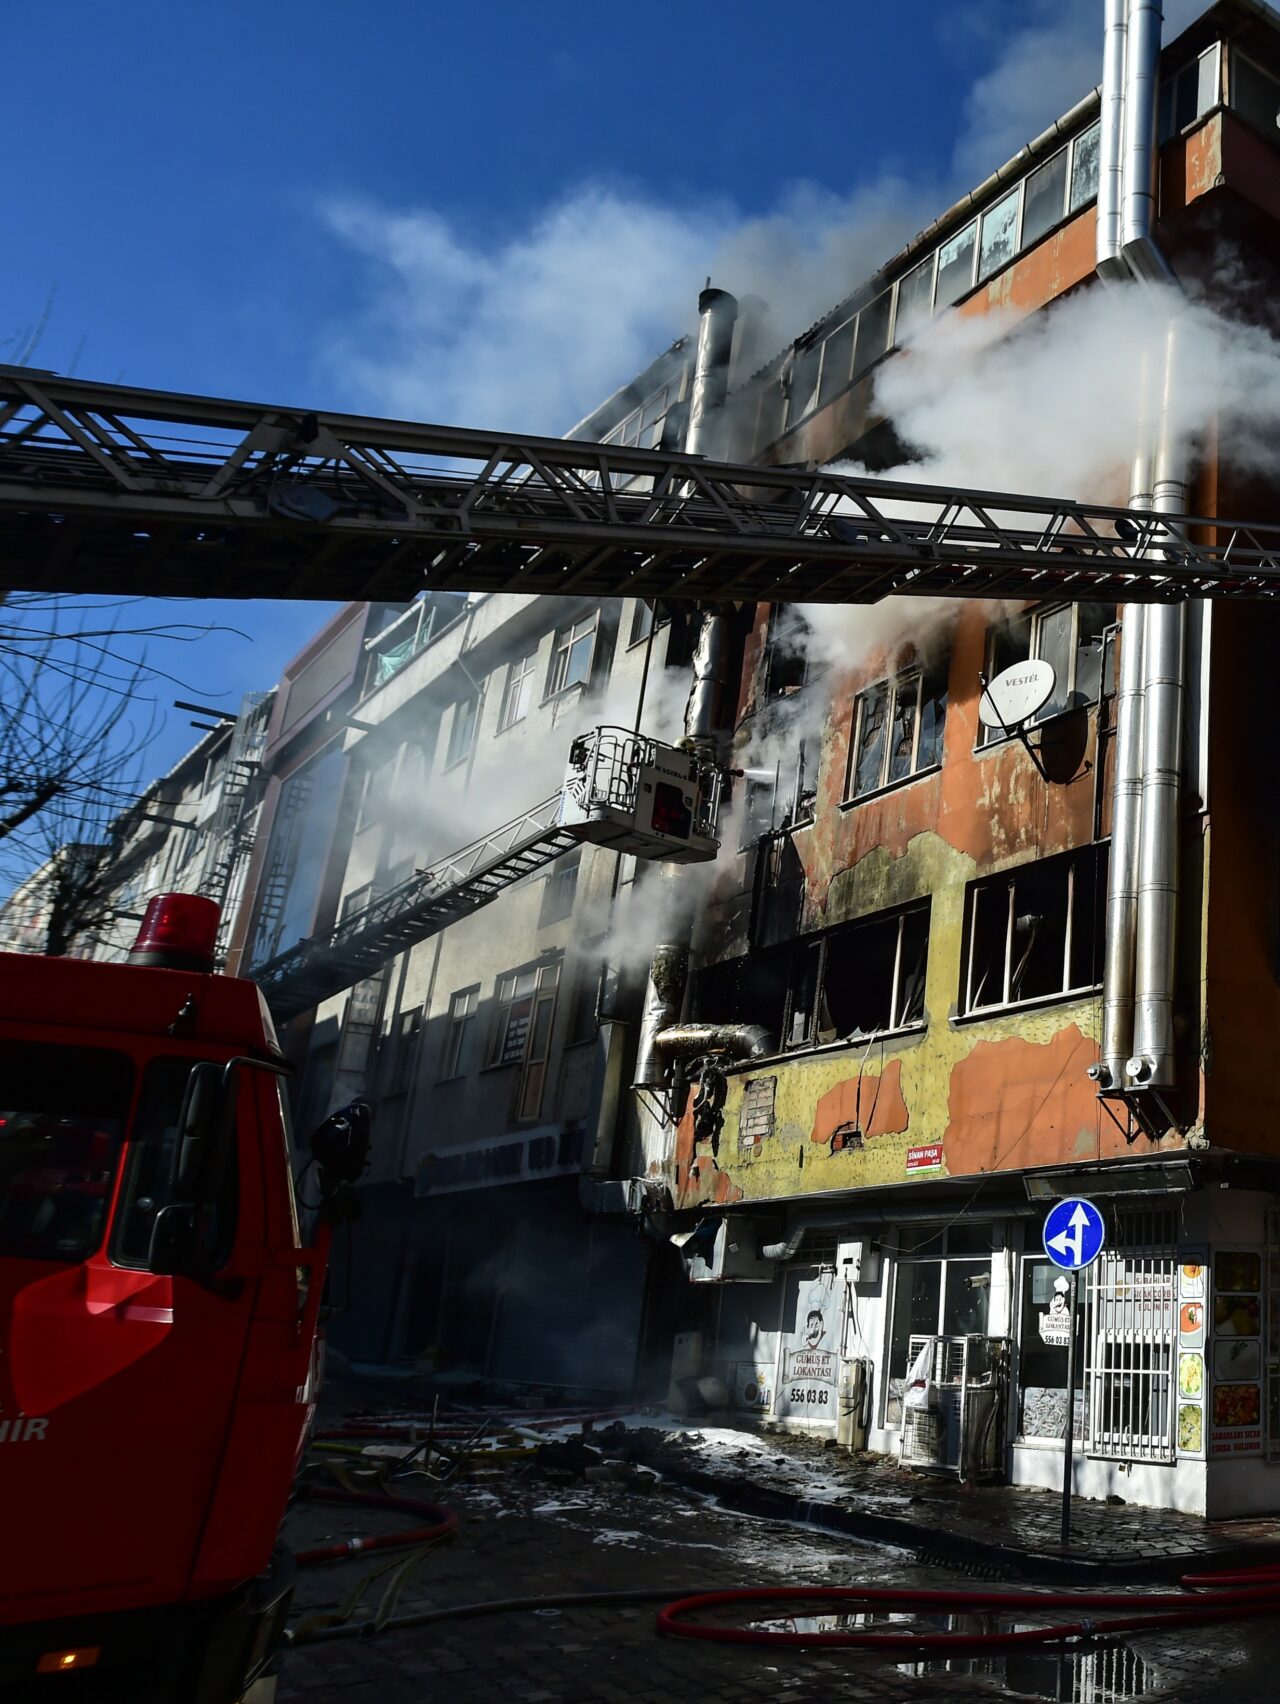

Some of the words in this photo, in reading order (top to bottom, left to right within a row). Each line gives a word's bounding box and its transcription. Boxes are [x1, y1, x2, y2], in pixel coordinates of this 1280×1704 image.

[1005, 673, 1040, 687] VESTEL
[924, 1148, 938, 1159] PAŞA
[1138, 1303, 1170, 1312] BULNR
[1045, 1335, 1055, 1344] 556
[1055, 1336, 1063, 1344] 03
[796, 1352, 821, 1367] GÜMÜŞ
[821, 1355, 831, 1365] ET
[793, 1366, 832, 1378] LOKANTASI
[790, 1388, 805, 1403] 556
[806, 1389, 817, 1404] 03
[818, 1390, 829, 1405] 83
